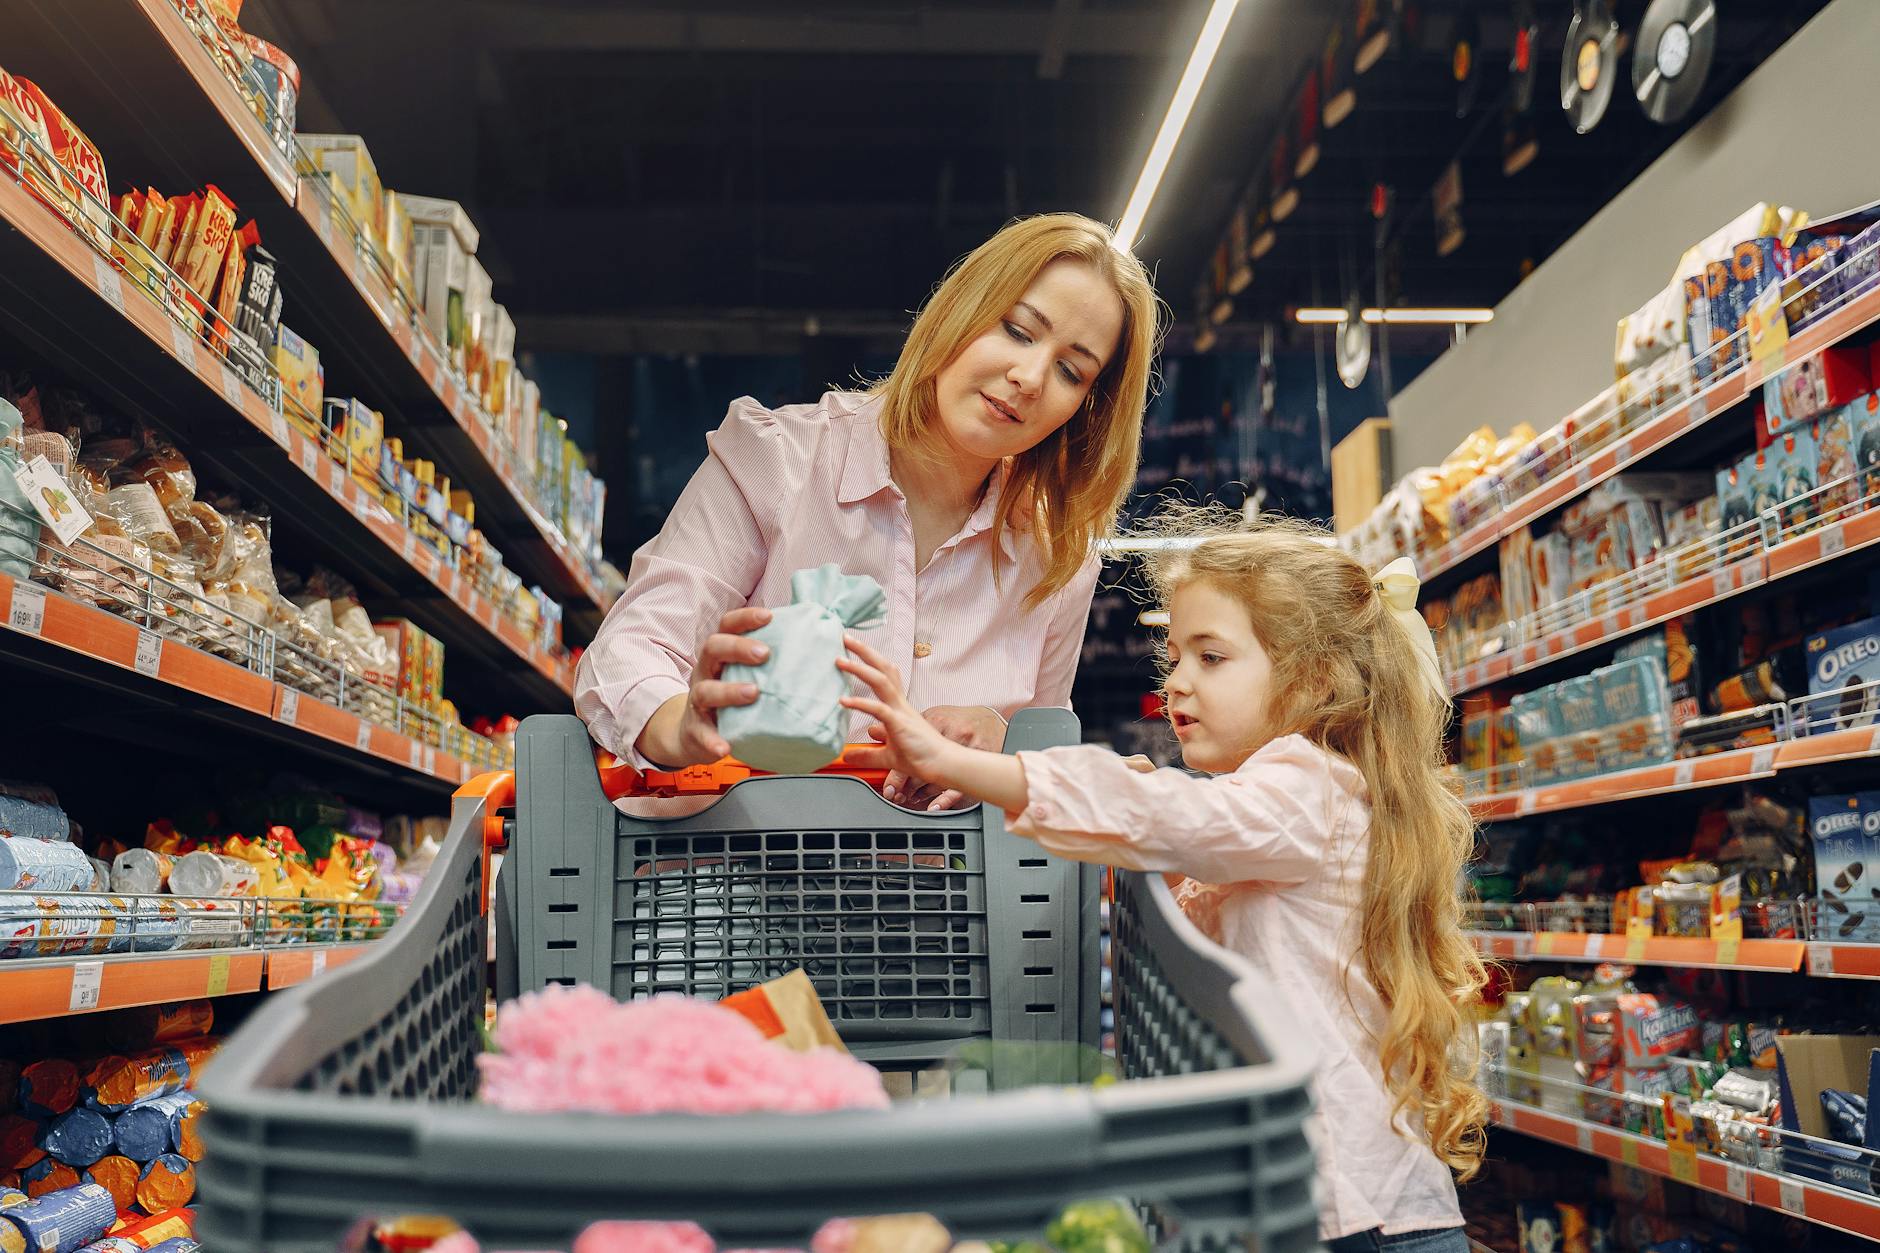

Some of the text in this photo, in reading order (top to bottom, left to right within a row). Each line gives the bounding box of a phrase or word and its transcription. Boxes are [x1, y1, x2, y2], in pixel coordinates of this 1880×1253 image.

[203, 227, 227, 254] SKO
[248, 282, 269, 308] SKO
[1817, 636, 1879, 682] OREO
